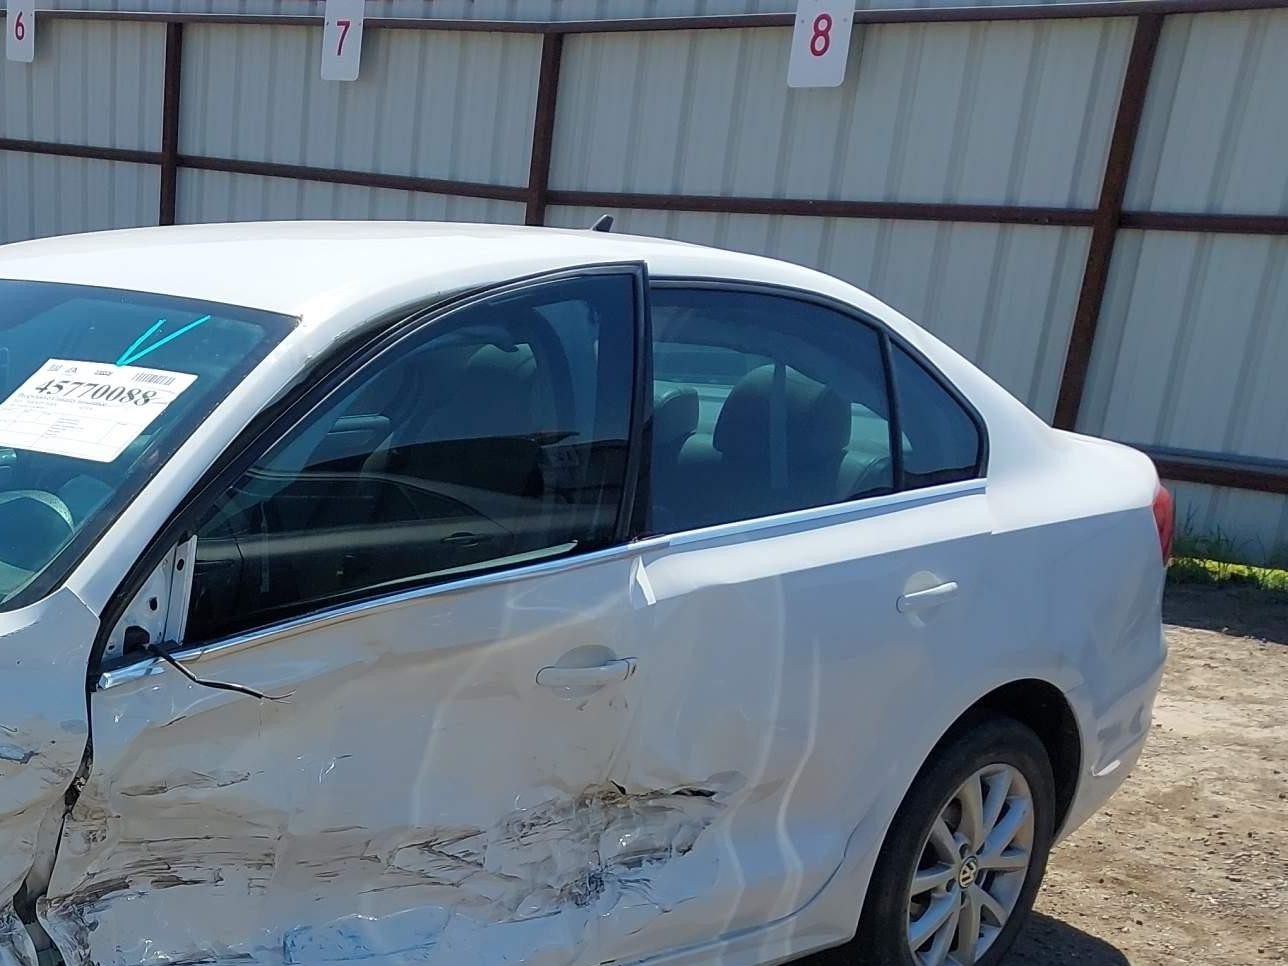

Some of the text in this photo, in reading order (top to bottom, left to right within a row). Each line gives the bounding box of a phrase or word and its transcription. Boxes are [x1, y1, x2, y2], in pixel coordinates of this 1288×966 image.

[15, 11, 25, 41] 6
[336, 20, 351, 56] 7
[809, 13, 833, 57] 8
[34, 378, 158, 407] 45770088
